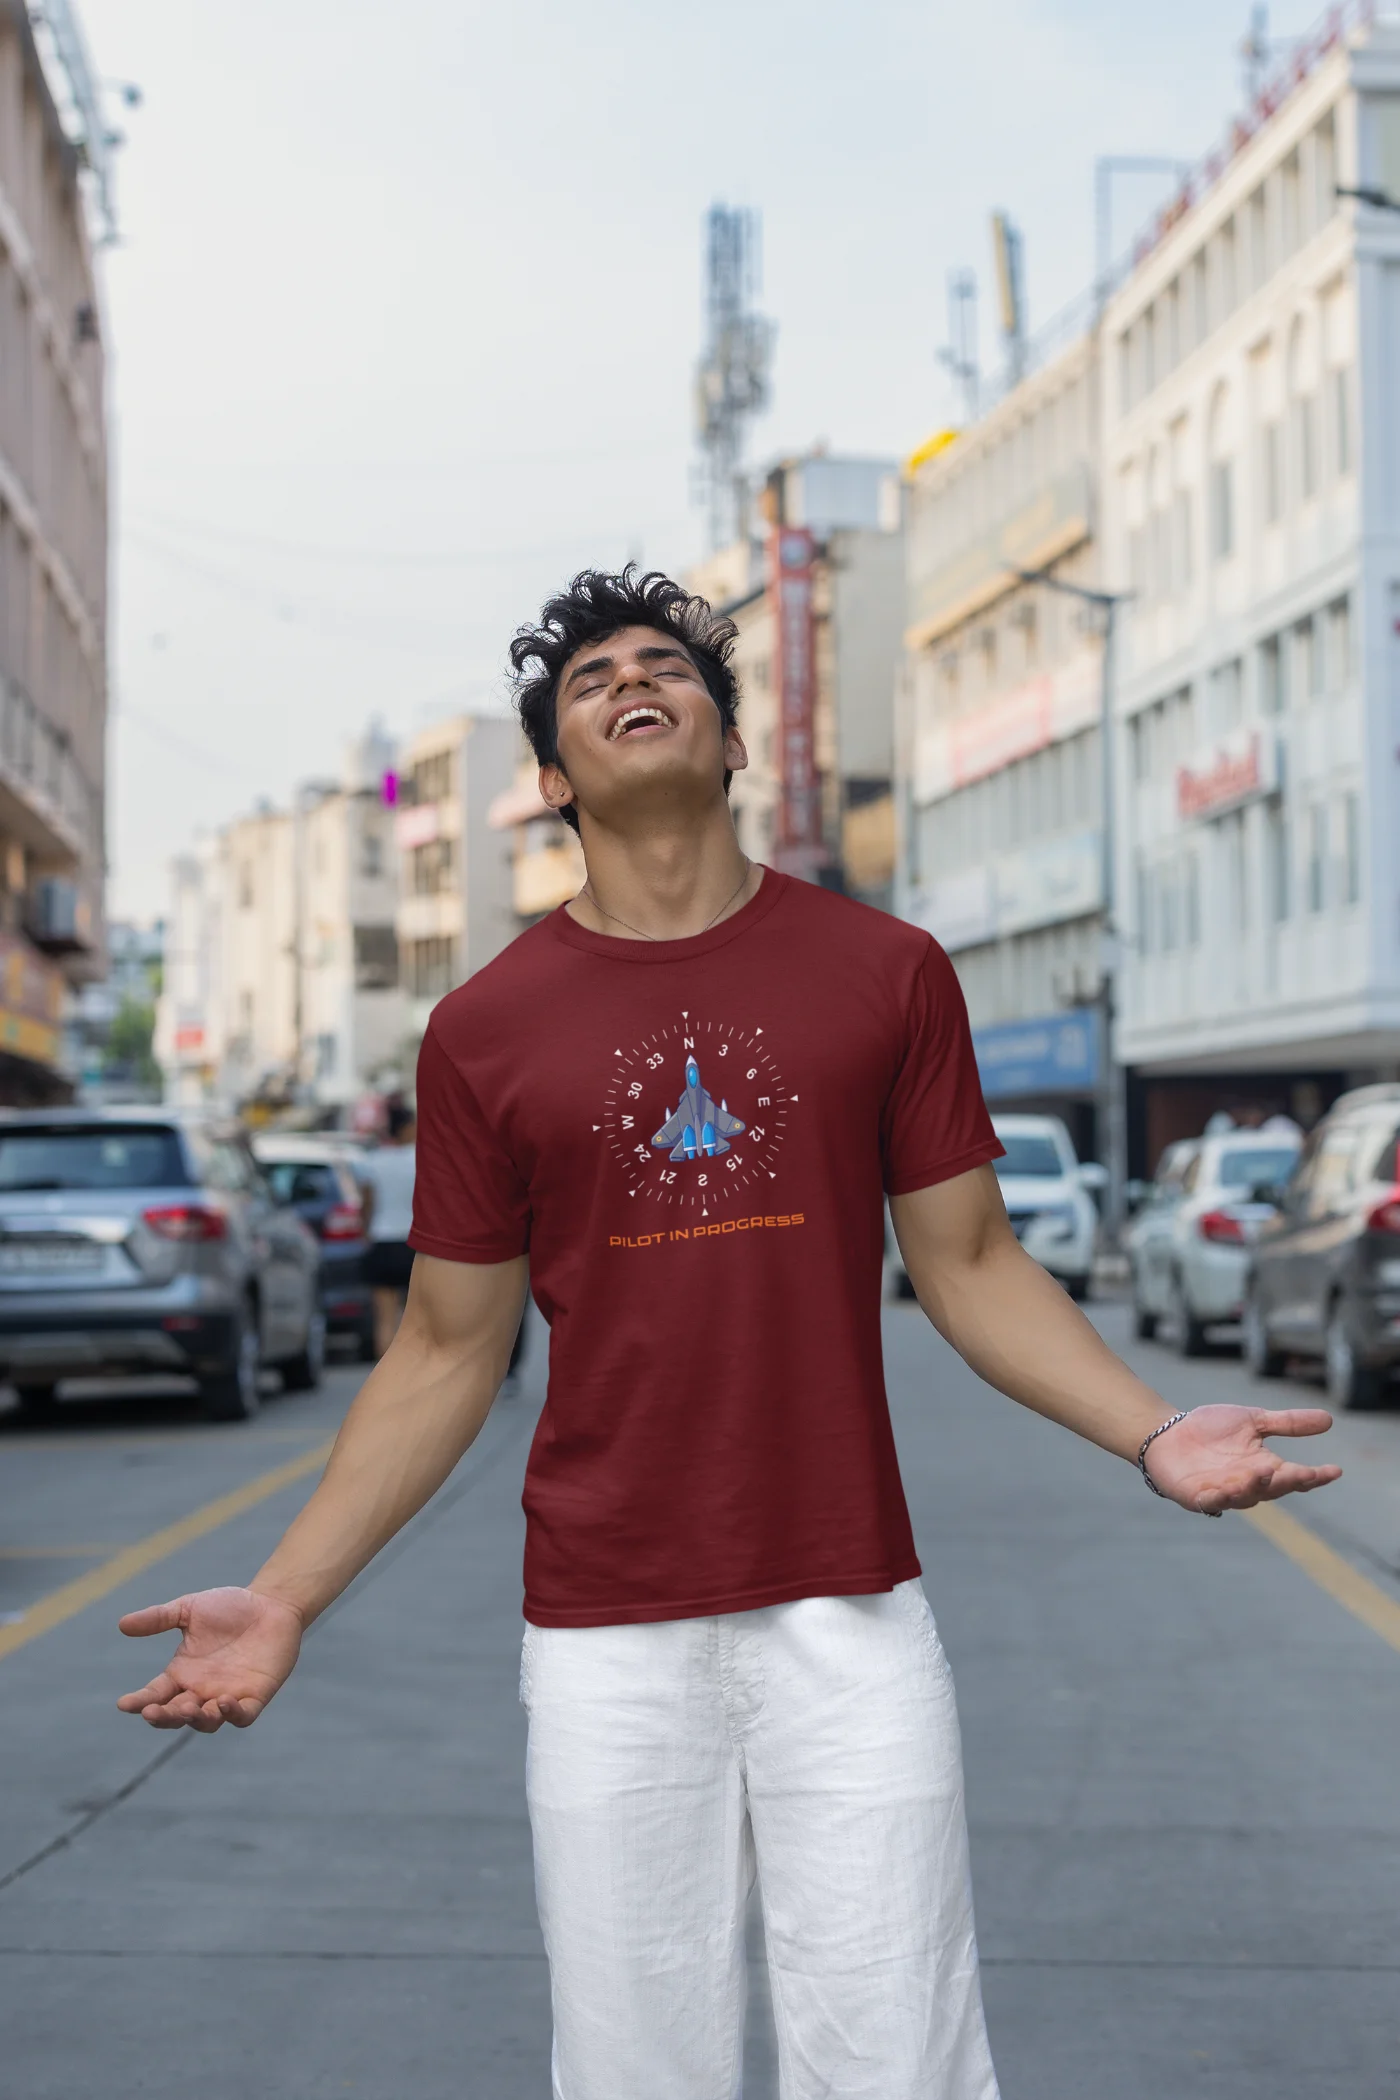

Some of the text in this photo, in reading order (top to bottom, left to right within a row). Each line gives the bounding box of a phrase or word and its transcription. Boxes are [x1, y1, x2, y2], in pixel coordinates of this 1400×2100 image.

[683, 1036, 695, 1050] N
[718, 1044, 729, 1057] 3
[646, 1052, 664, 1070] 33
[627, 1082, 643, 1100] 30
[757, 1096, 770, 1107] E
[621, 1114, 635, 1130] W
[748, 1125, 766, 1142] 12
[633, 1143, 652, 1163] 24
[726, 1154, 743, 1172] 15
[659, 1169, 677, 1185] 21
[609, 1213, 805, 1248] PILOT IN PROGRESS
